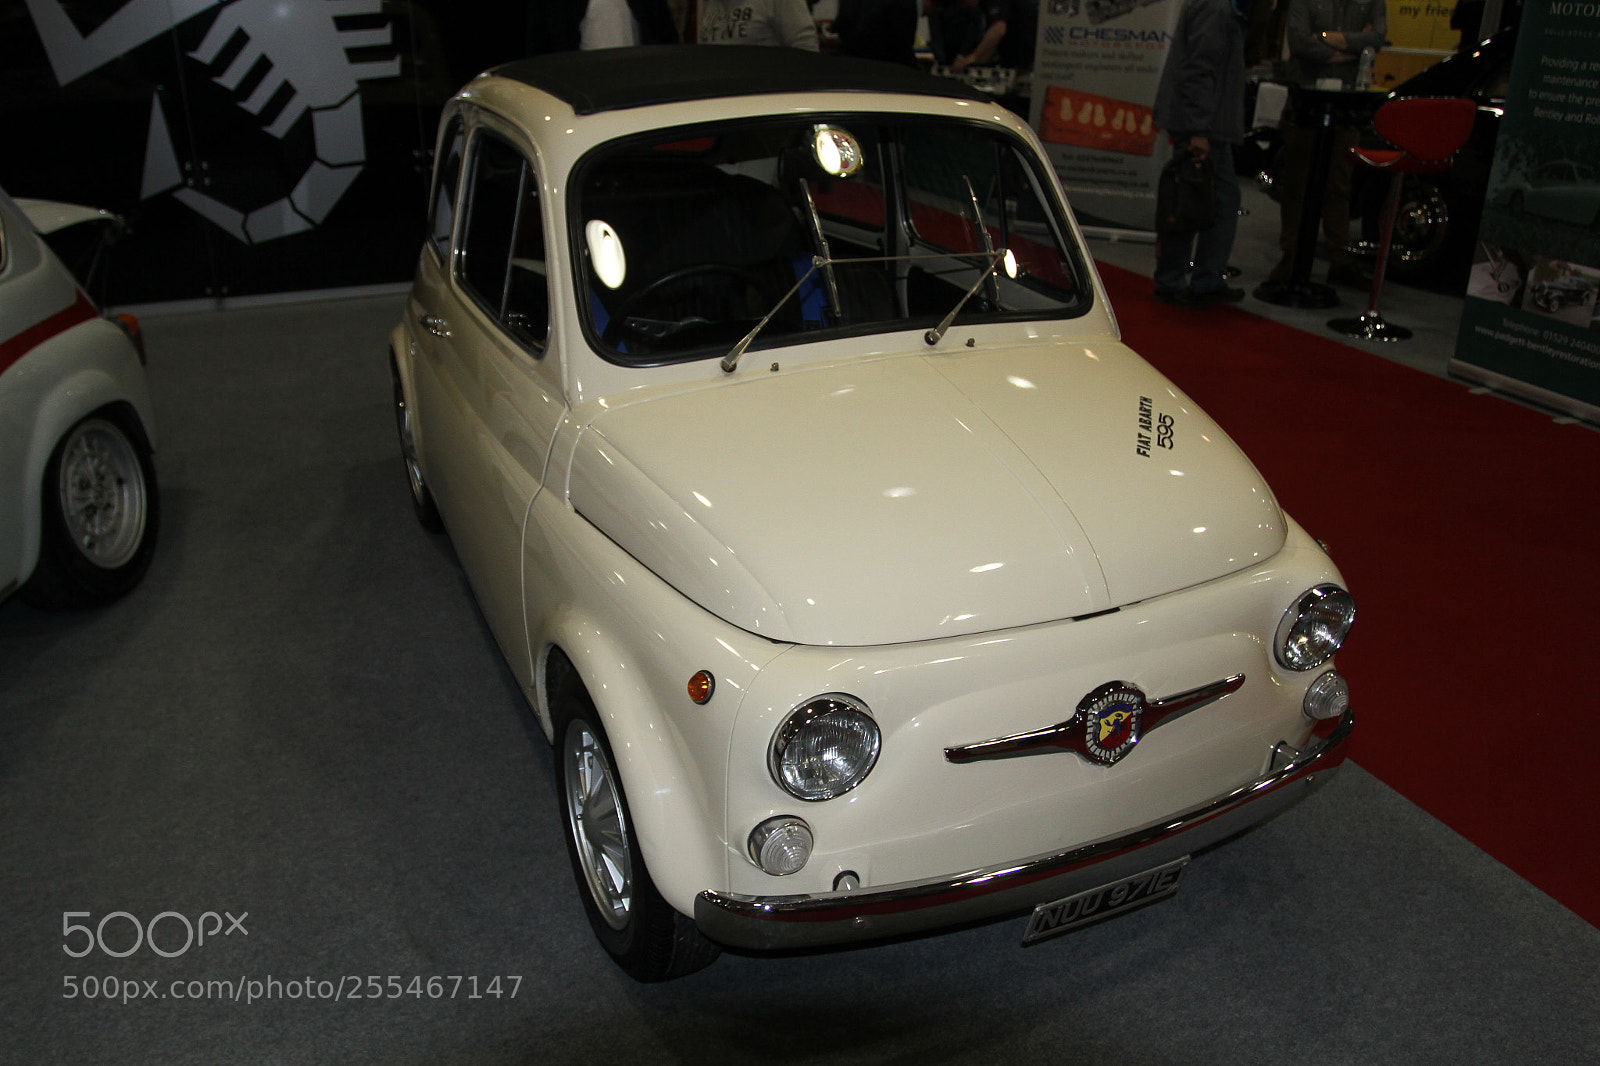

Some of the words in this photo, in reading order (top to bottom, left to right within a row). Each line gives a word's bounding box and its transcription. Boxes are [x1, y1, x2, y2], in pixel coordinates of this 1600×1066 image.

[1399, 5, 1420, 19] my
[1069, 26, 1175, 43] CHESMAN
[1541, 55, 1579, 72] Providing
[1580, 62, 1588, 72] a
[1543, 75, 1599, 89] maintenance
[1538, 91, 1566, 103] ensure
[1568, 92, 1584, 105] the
[1533, 106, 1564, 122] Bentley
[1564, 112, 1584, 123] and
[1138, 395, 1153, 432] ABARTH
[1157, 412, 1175, 450] 595
[1136, 432, 1152, 458] FIAT
[1039, 891, 1105, 931] NUU
[1108, 870, 1178, 907] 971E
